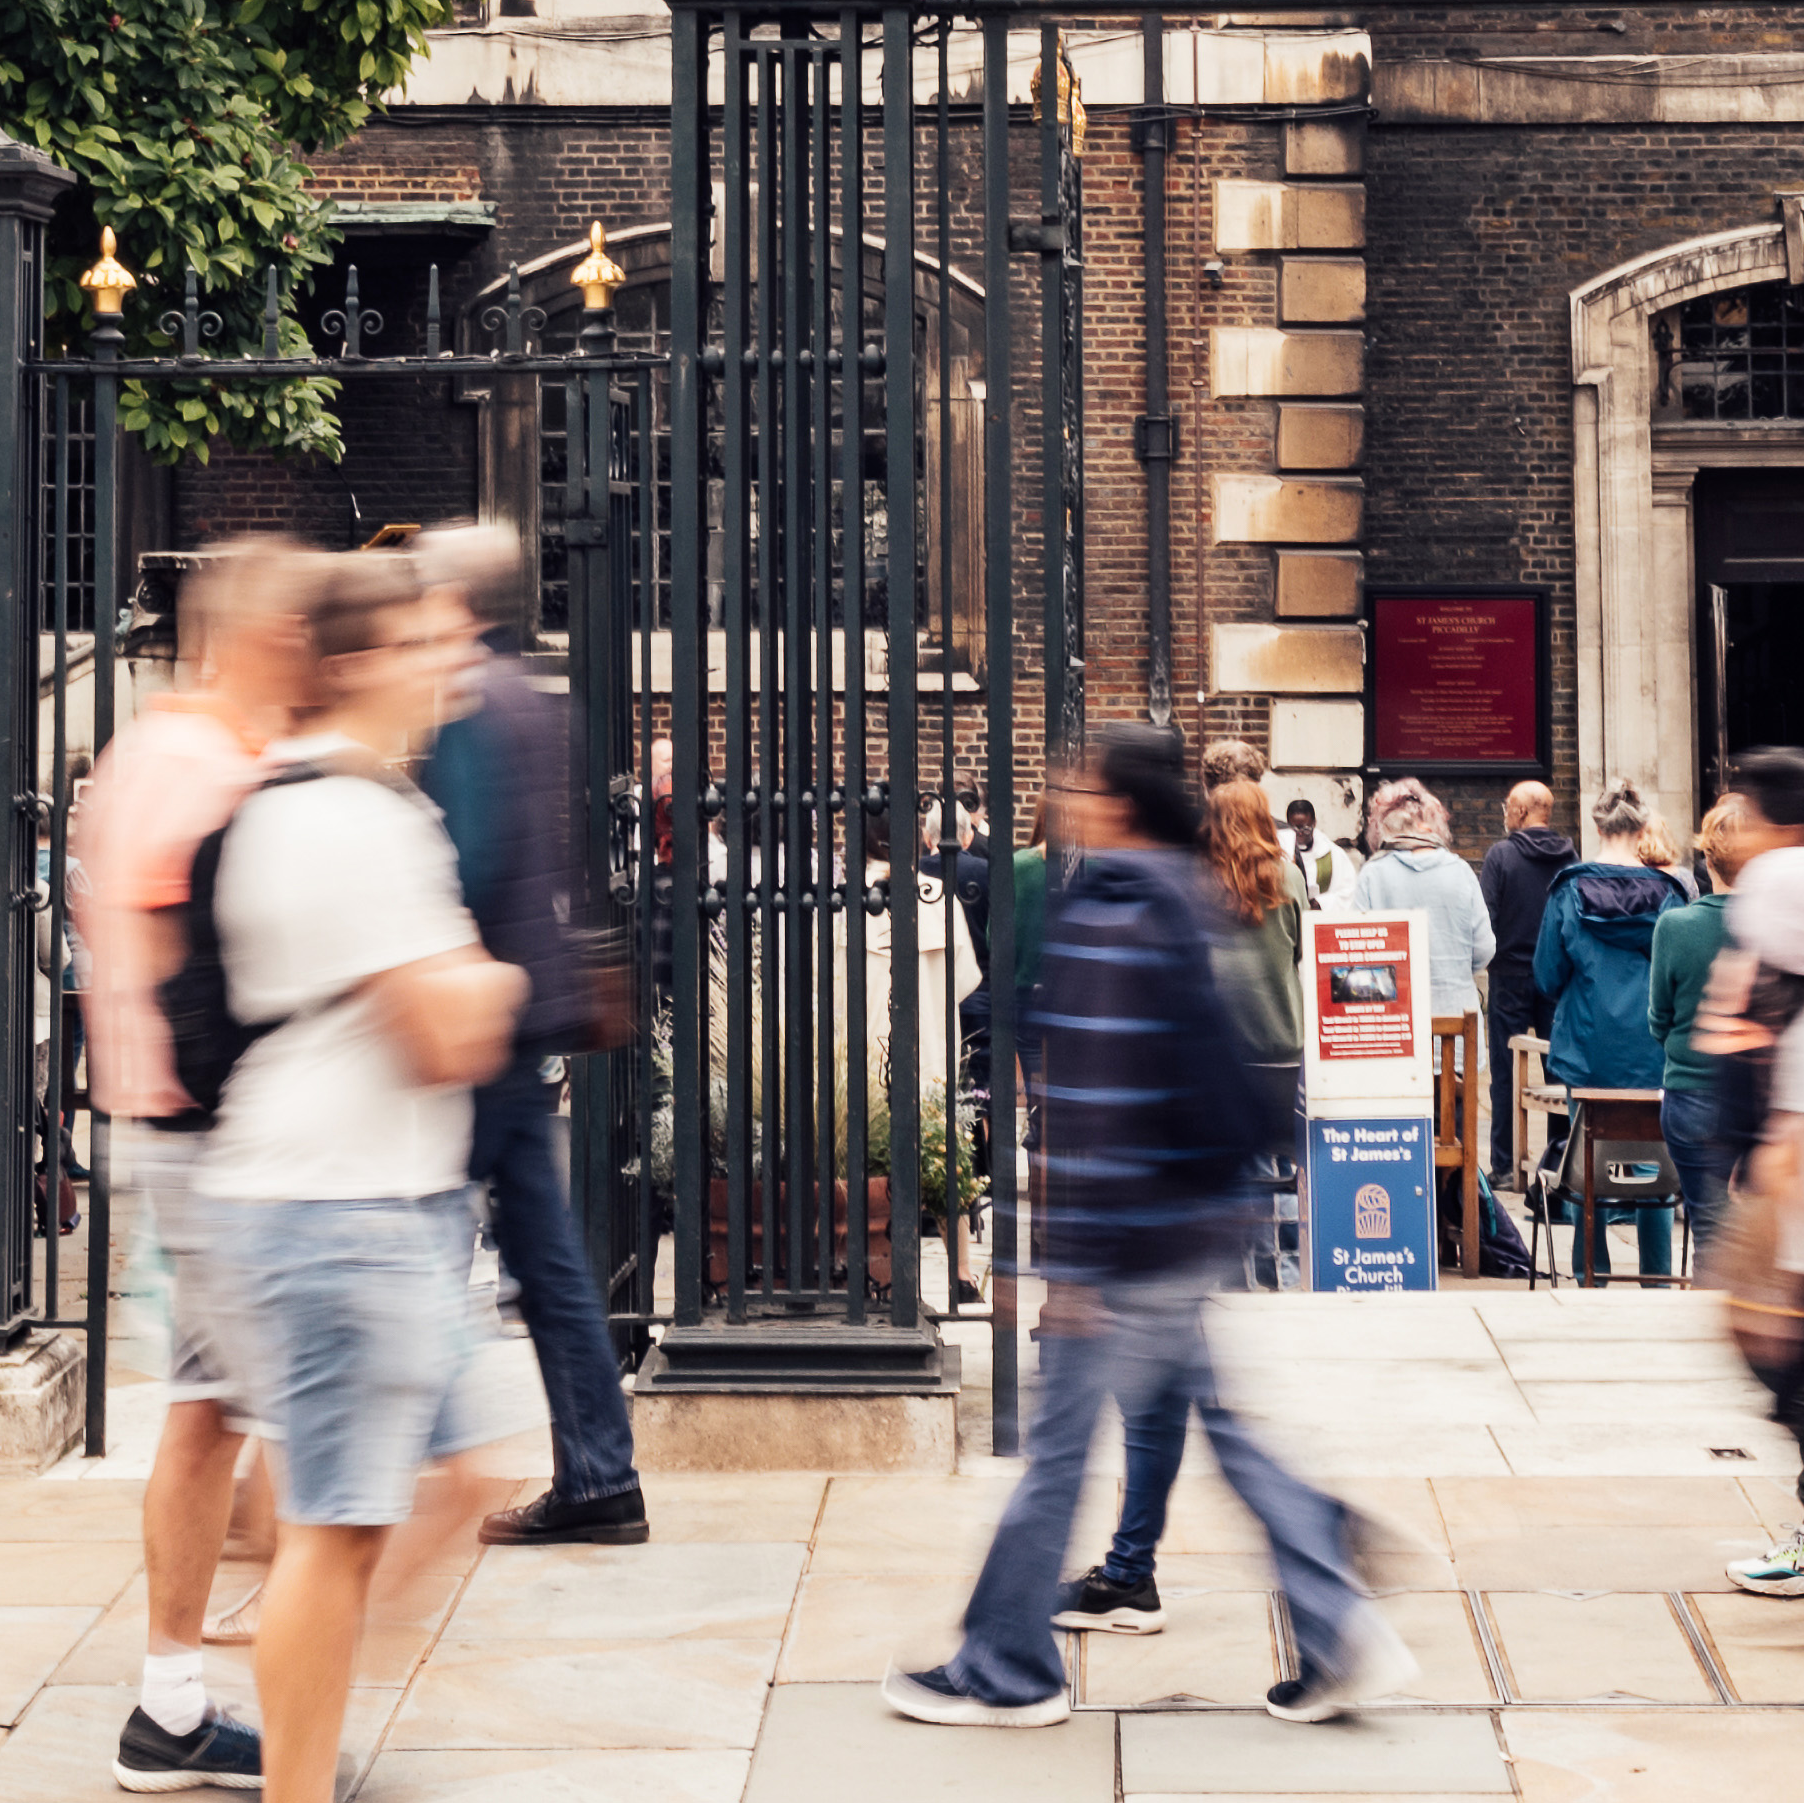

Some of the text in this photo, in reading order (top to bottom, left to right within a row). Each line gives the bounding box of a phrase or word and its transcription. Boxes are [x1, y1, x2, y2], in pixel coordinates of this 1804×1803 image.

[1322, 1126, 1419, 1143] The Heart of
[1331, 1146, 1412, 1162] St James's
[1333, 1246, 1415, 1265] St James's
[1344, 1266, 1404, 1284] Church
